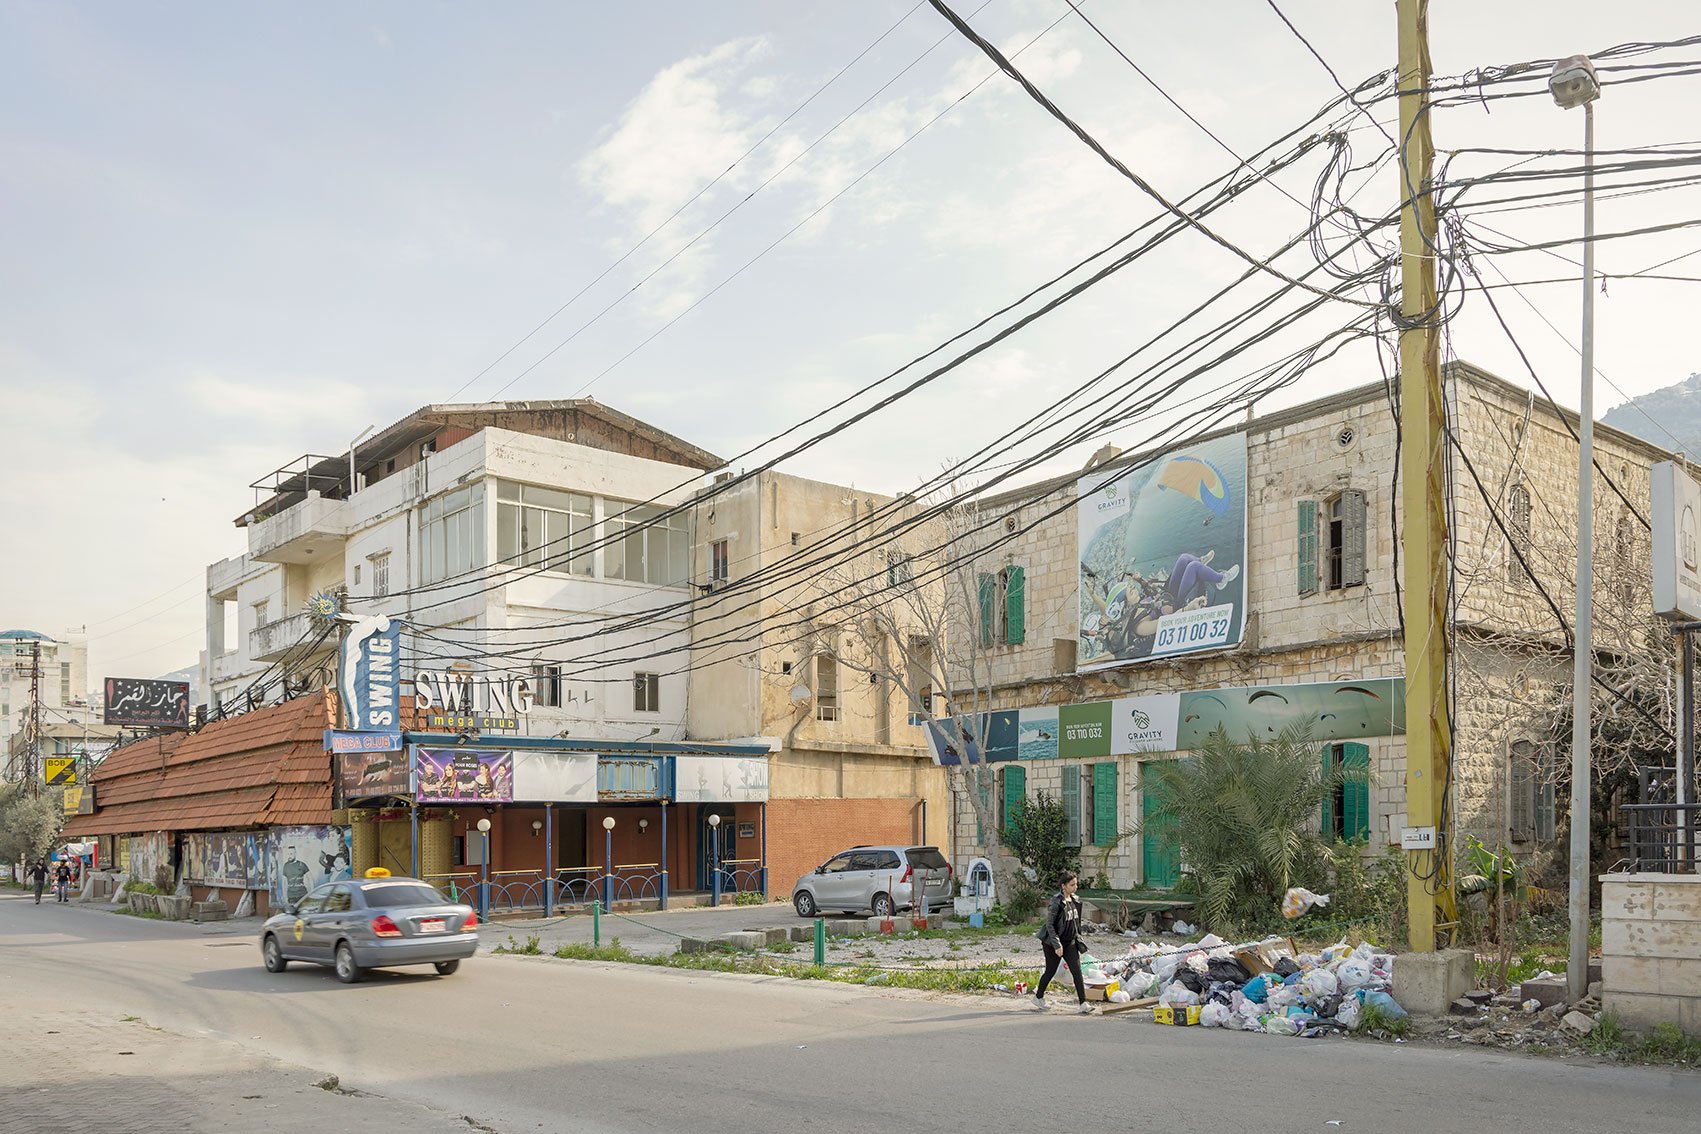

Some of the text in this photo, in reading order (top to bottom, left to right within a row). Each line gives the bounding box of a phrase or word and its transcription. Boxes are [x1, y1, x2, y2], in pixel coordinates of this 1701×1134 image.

[1158, 619, 1228, 647] 03 11 00 32
[369, 637, 393, 727] SWING
[415, 671, 534, 714] SWING
[434, 716, 515, 729] mega club
[1066, 727, 1103, 740] 03 110 032
[1127, 730, 1162, 741] GRAVITY
[332, 735, 391, 749] MEGA CLUB
